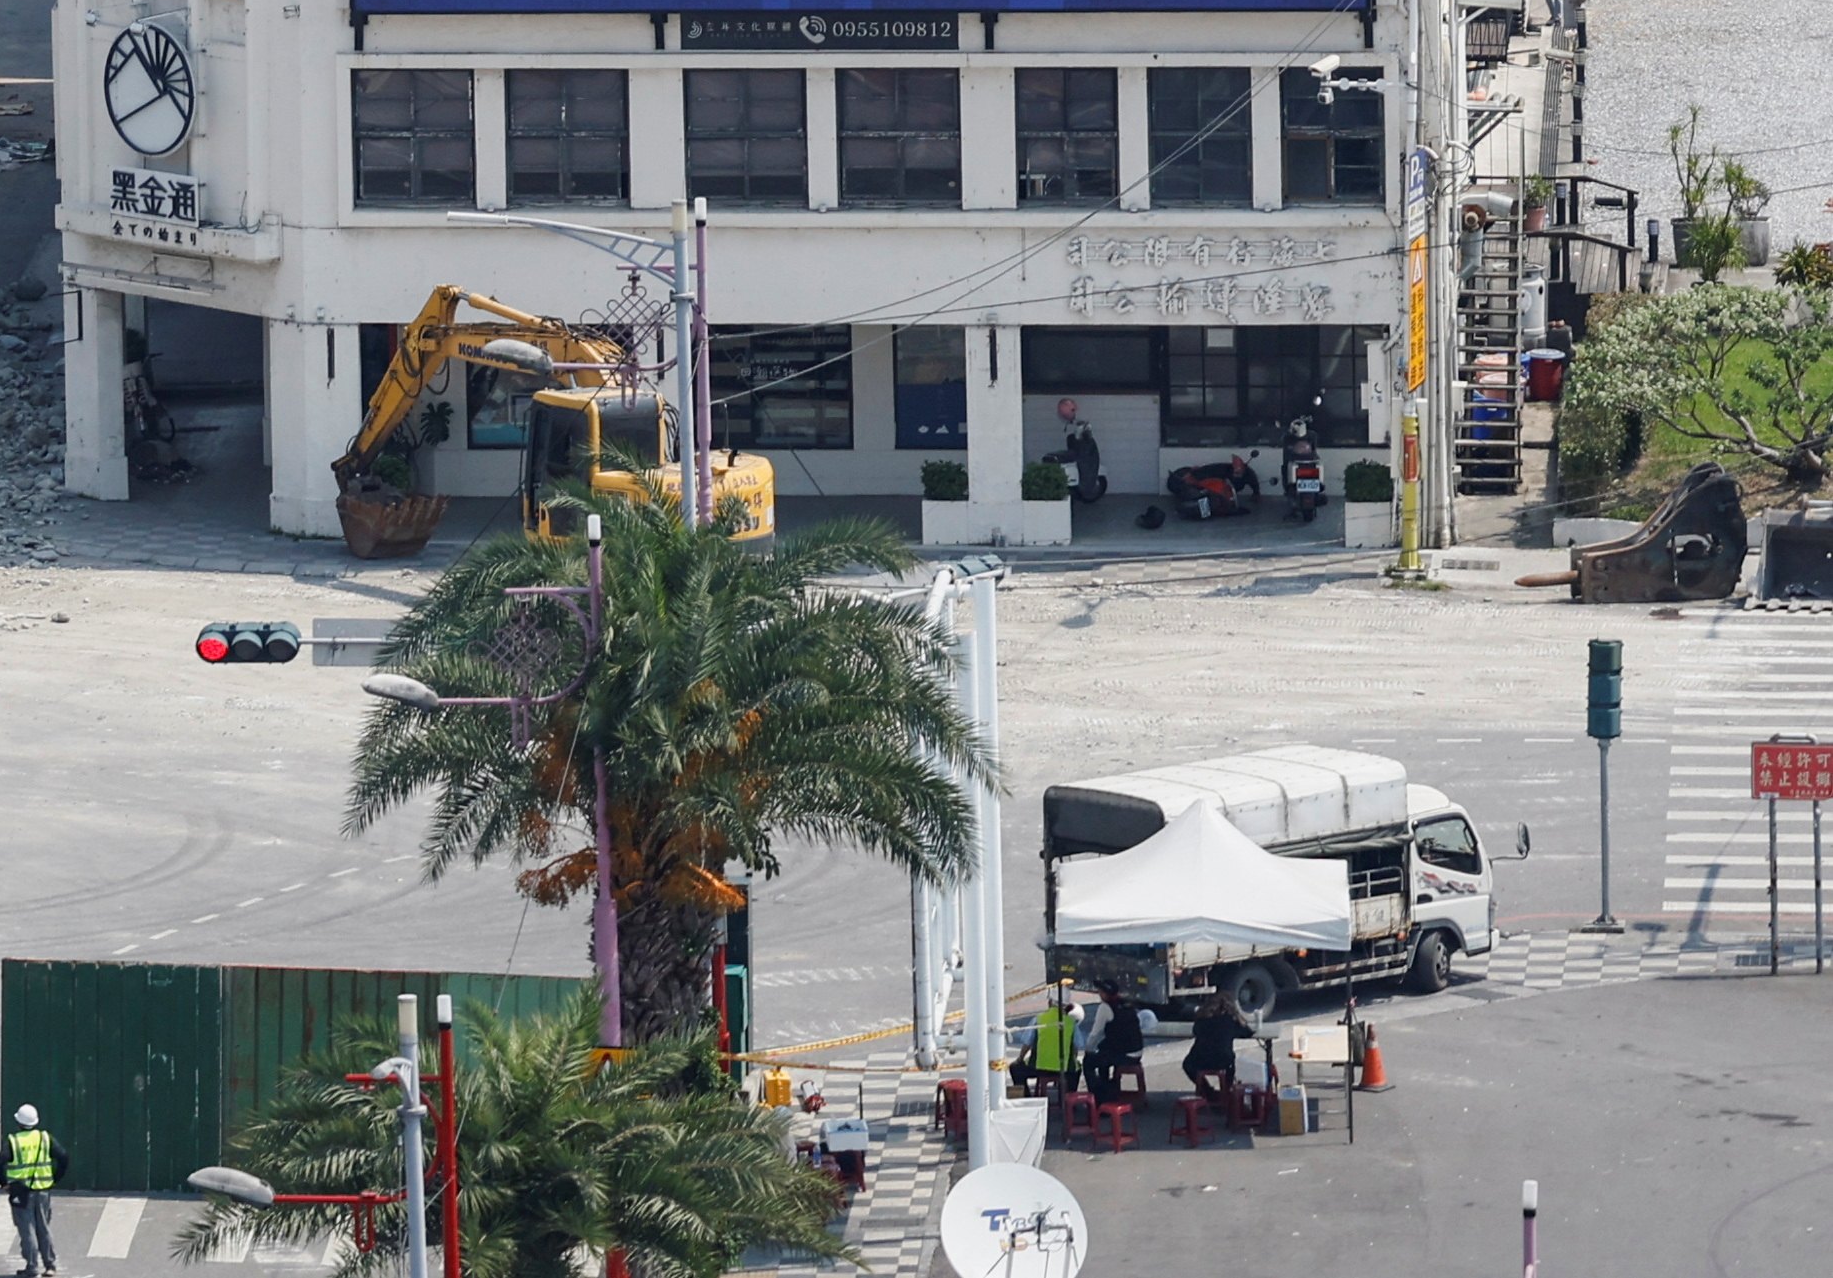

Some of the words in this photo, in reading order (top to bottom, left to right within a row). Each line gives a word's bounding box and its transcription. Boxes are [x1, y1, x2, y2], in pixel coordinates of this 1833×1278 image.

[832, 21, 952, 37] 0955109812
[110, 170, 197, 222] 黑金通
[112, 220, 197, 246] 全ての始まり
